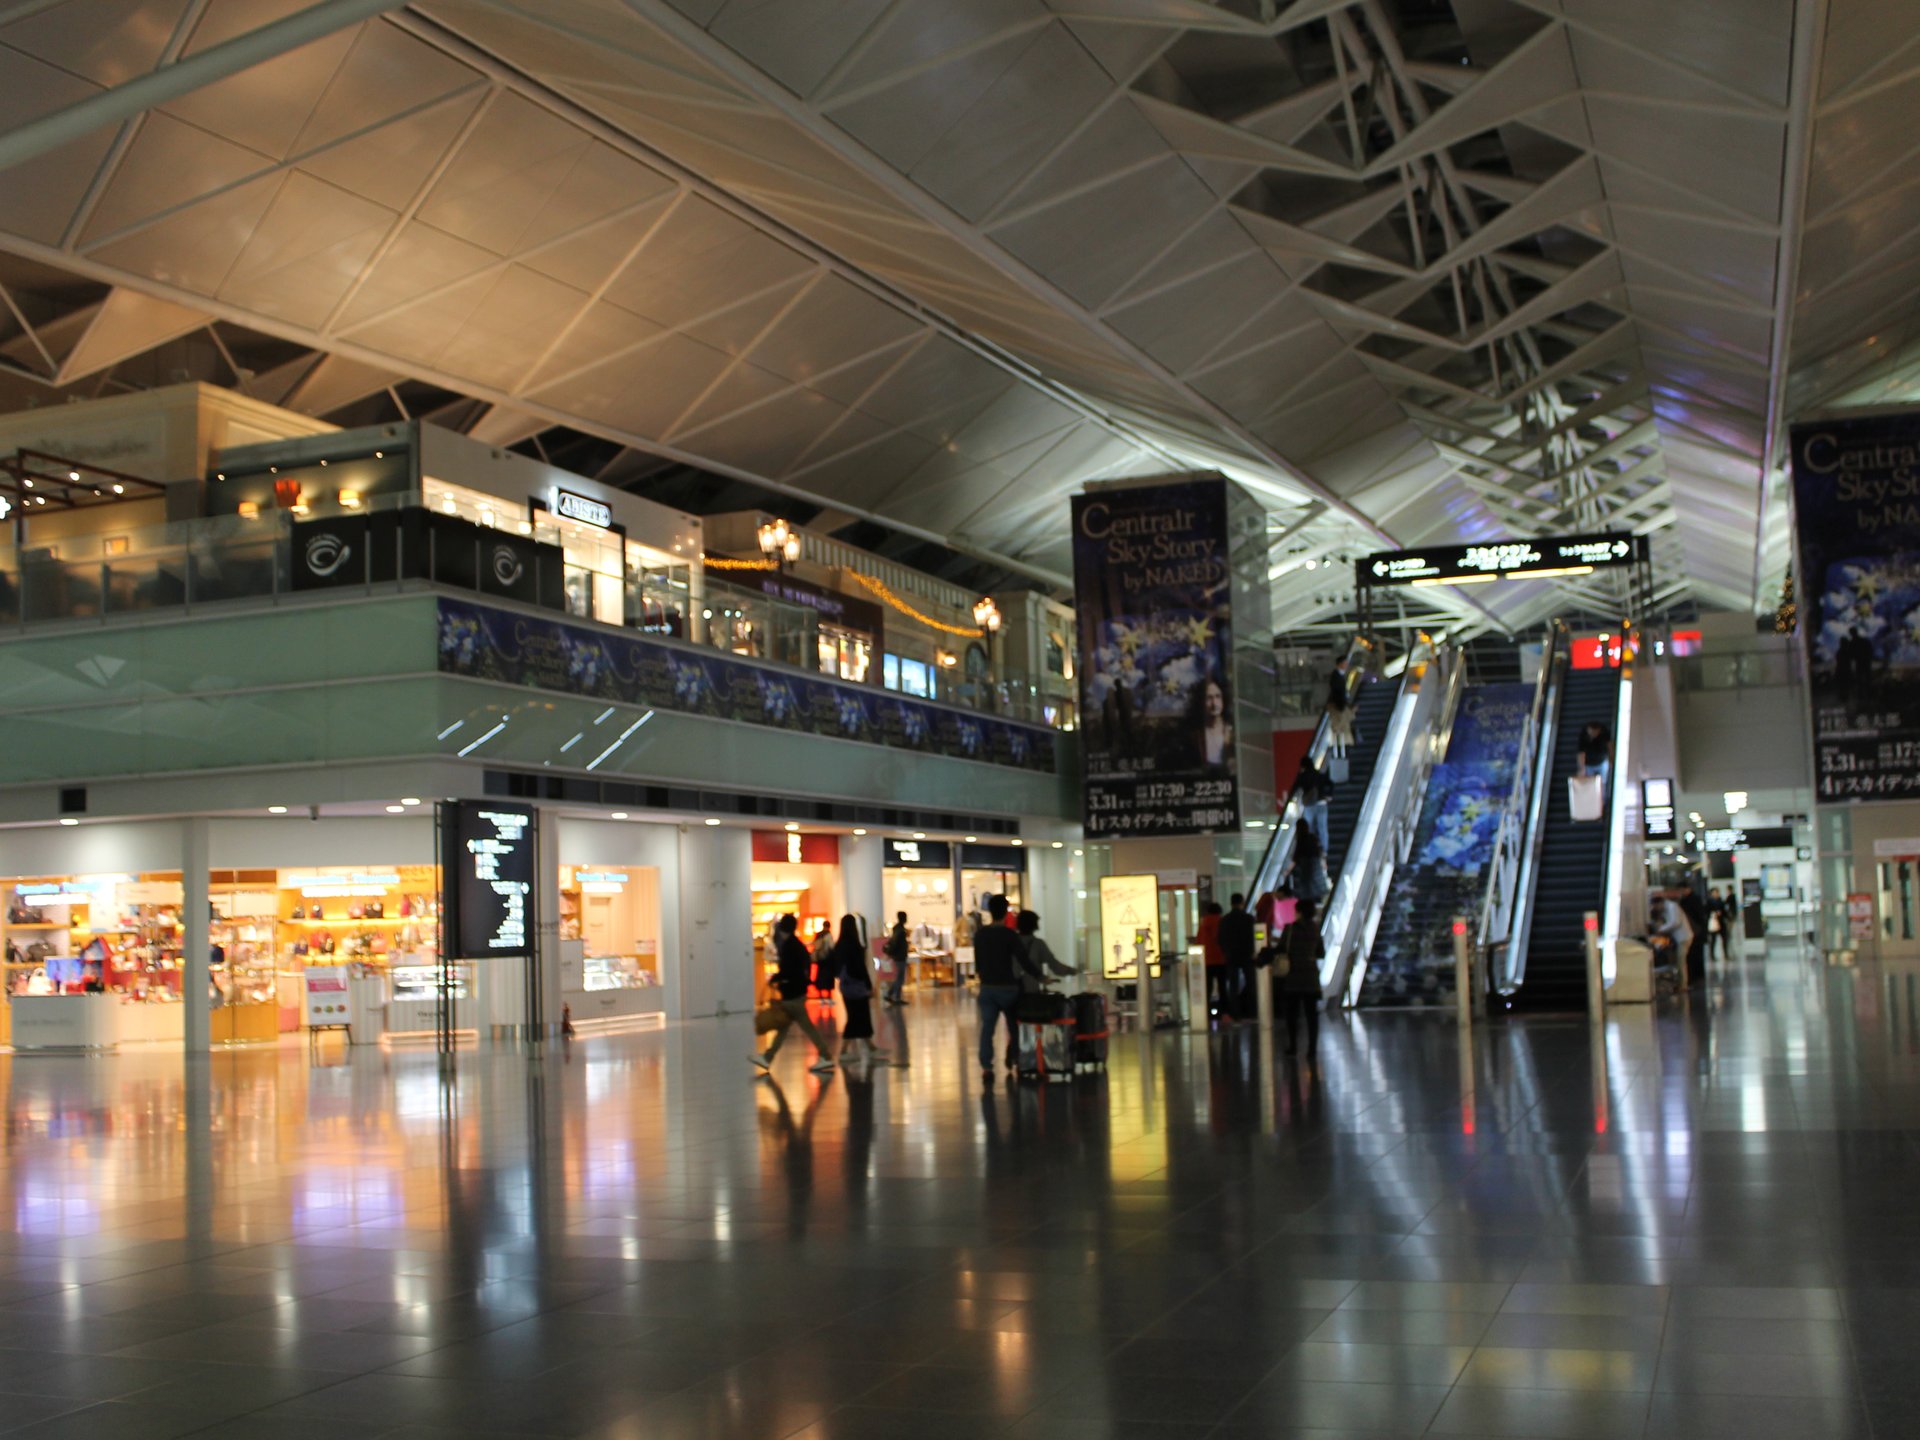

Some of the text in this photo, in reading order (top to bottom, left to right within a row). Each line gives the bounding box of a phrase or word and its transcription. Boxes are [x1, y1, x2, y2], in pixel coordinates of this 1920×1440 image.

[1836, 471, 1890, 506] Sky
[1081, 502, 1195, 539] Centrair
[1107, 533, 1216, 568] Sky Story
[1123, 561, 1221, 593] by NAKED
